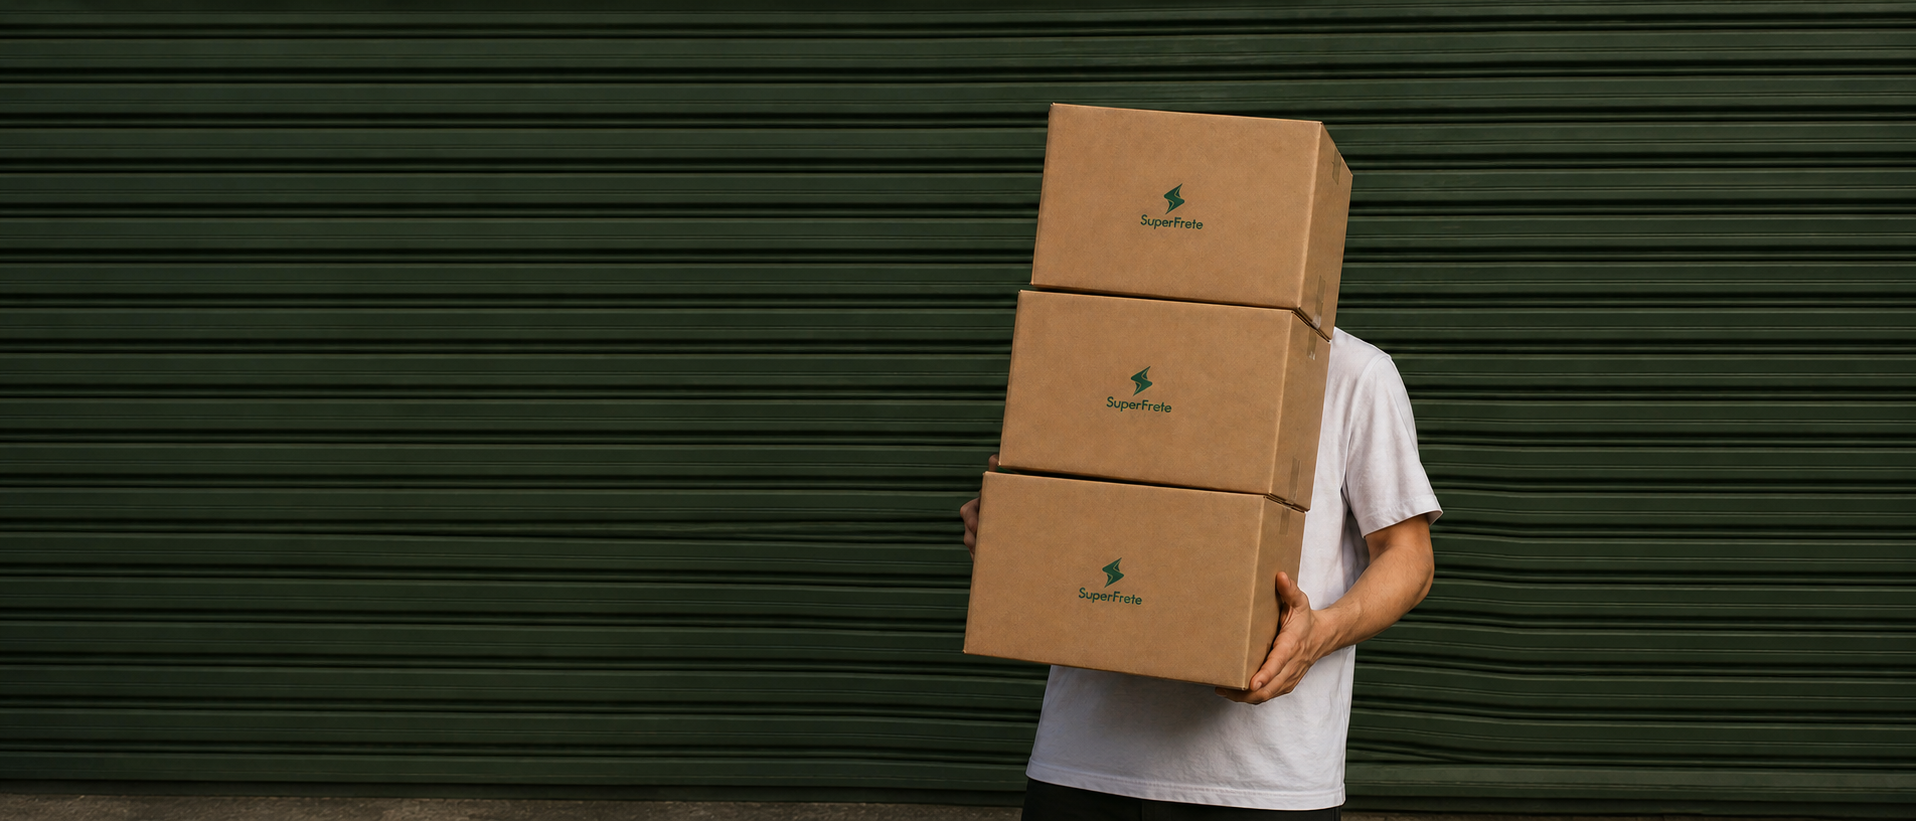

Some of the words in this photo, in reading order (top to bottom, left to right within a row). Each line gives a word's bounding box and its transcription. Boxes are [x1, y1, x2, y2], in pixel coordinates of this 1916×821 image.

[1140, 214, 1203, 230] SuperFrete
[1106, 396, 1172, 413] SuperFrete
[1078, 587, 1142, 605] SuperFrete
